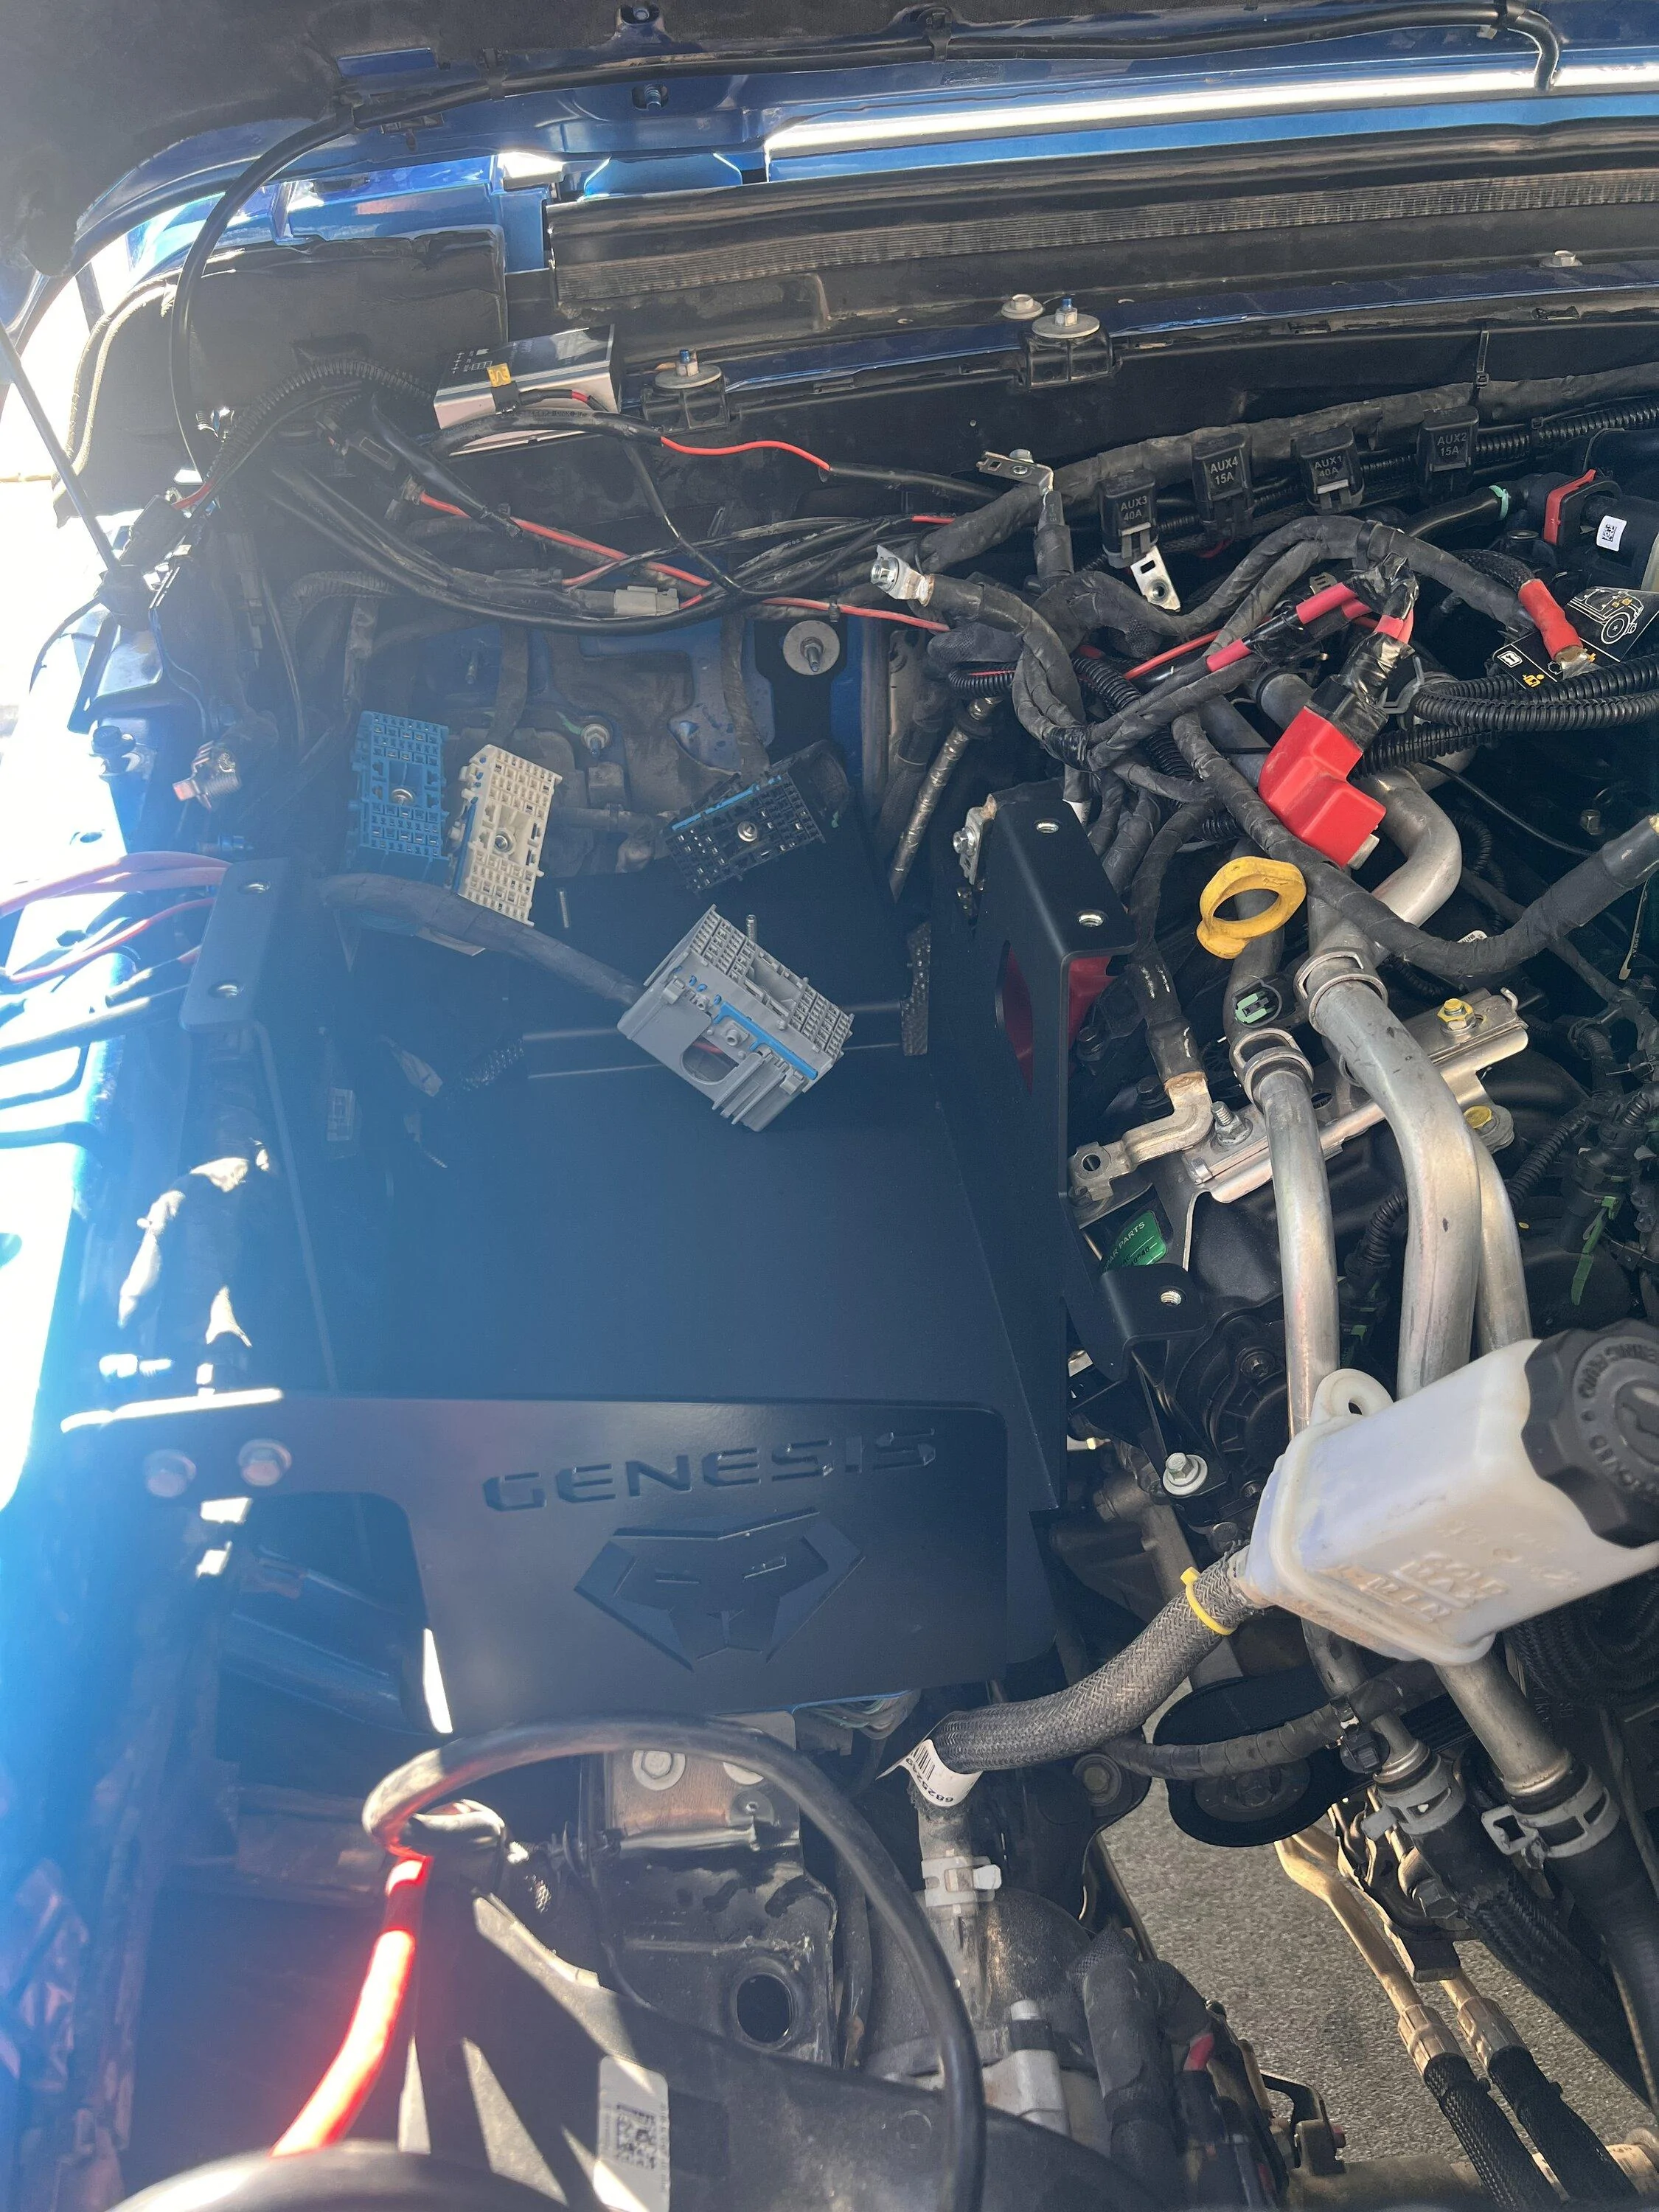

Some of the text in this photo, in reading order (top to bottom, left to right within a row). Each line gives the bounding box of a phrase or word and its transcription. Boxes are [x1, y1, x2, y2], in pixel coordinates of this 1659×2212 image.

[1437, 432, 1467, 445] AUX2
[1441, 445, 1459, 456] 15A
[1210, 456, 1239, 474] AUX4
[1315, 455, 1342, 469] AUX1
[1215, 471, 1234, 485] 15A
[1318, 467, 1339, 477] 40A
[1121, 495, 1148, 512] AUX3
[1124, 509, 1142, 521] 40A
[1119, 1221, 1146, 1249] PARTS
[481, 1427, 936, 1512] GENESIS
